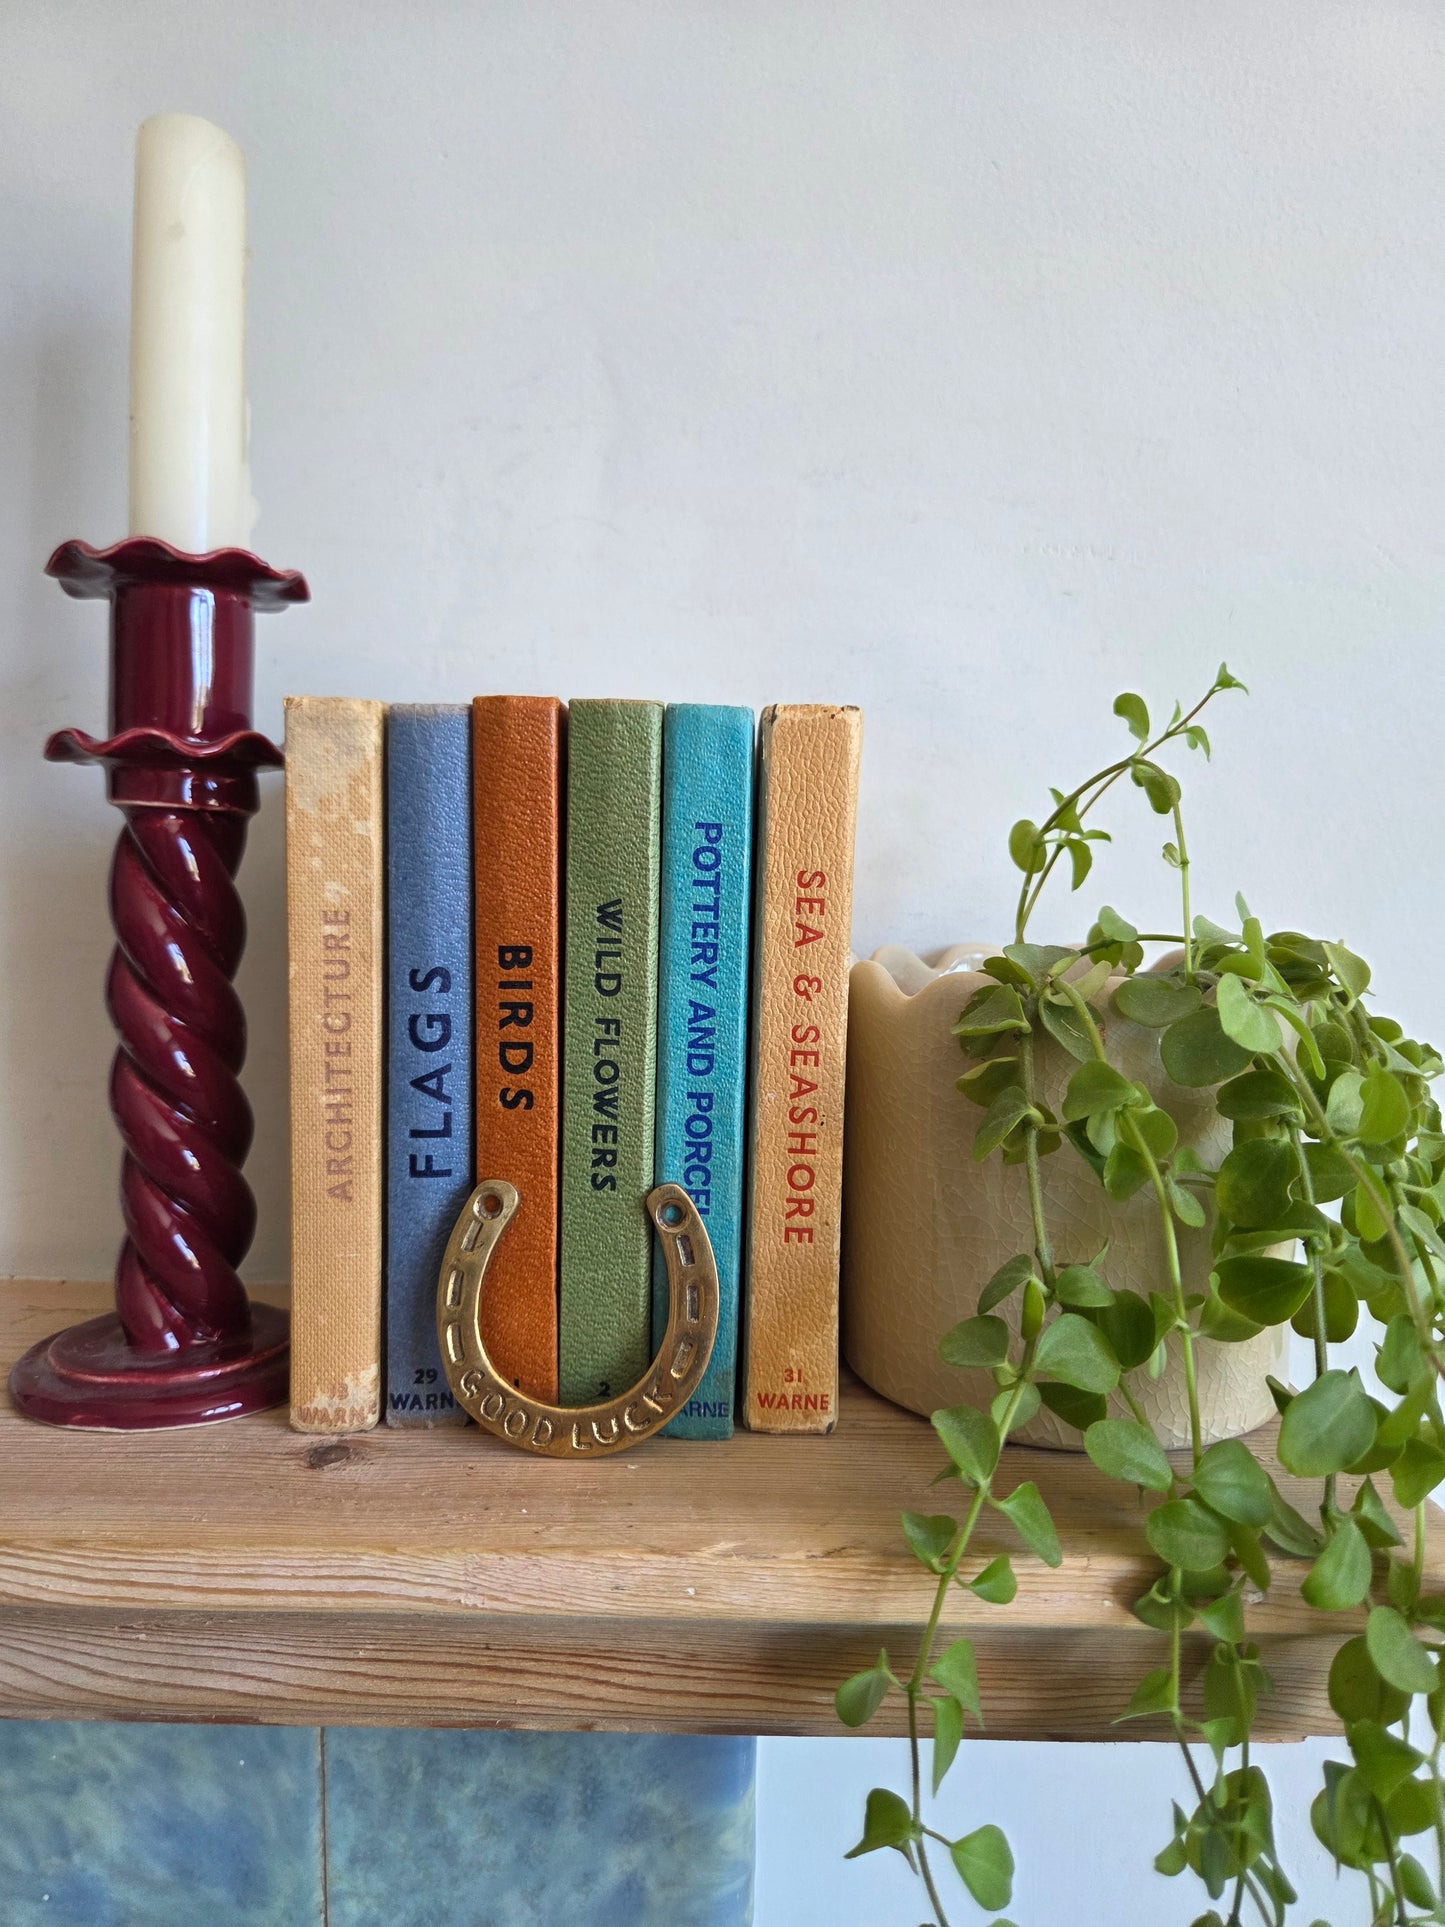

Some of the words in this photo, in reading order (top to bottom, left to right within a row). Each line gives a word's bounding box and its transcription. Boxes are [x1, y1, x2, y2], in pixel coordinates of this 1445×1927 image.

[690, 822, 723, 991] POTTERY
[794, 870, 826, 949] SEA
[593, 898, 622, 998] WILD
[792, 975, 822, 1001] &
[324, 908, 353, 1203] ARCHITECTURE
[498, 945, 534, 1111] BIRDS
[686, 1000, 716, 1078] AND
[409, 966, 452, 1179] FLAGS
[590, 1018, 621, 1193] FLOWERS
[784, 1025, 821, 1245] SEASHORE
[390, 1392, 455, 1410] WARN
[413, 1368, 438, 1384] 29
[460, 1368, 554, 1447] GOOD
[572, 1384, 673, 1450] LUCK
[596, 1382, 610, 1398] 2
[679, 1401, 729, 1418] ARNE
[756, 1393, 829, 1411] WARNE
[784, 1368, 803, 1383] 31
